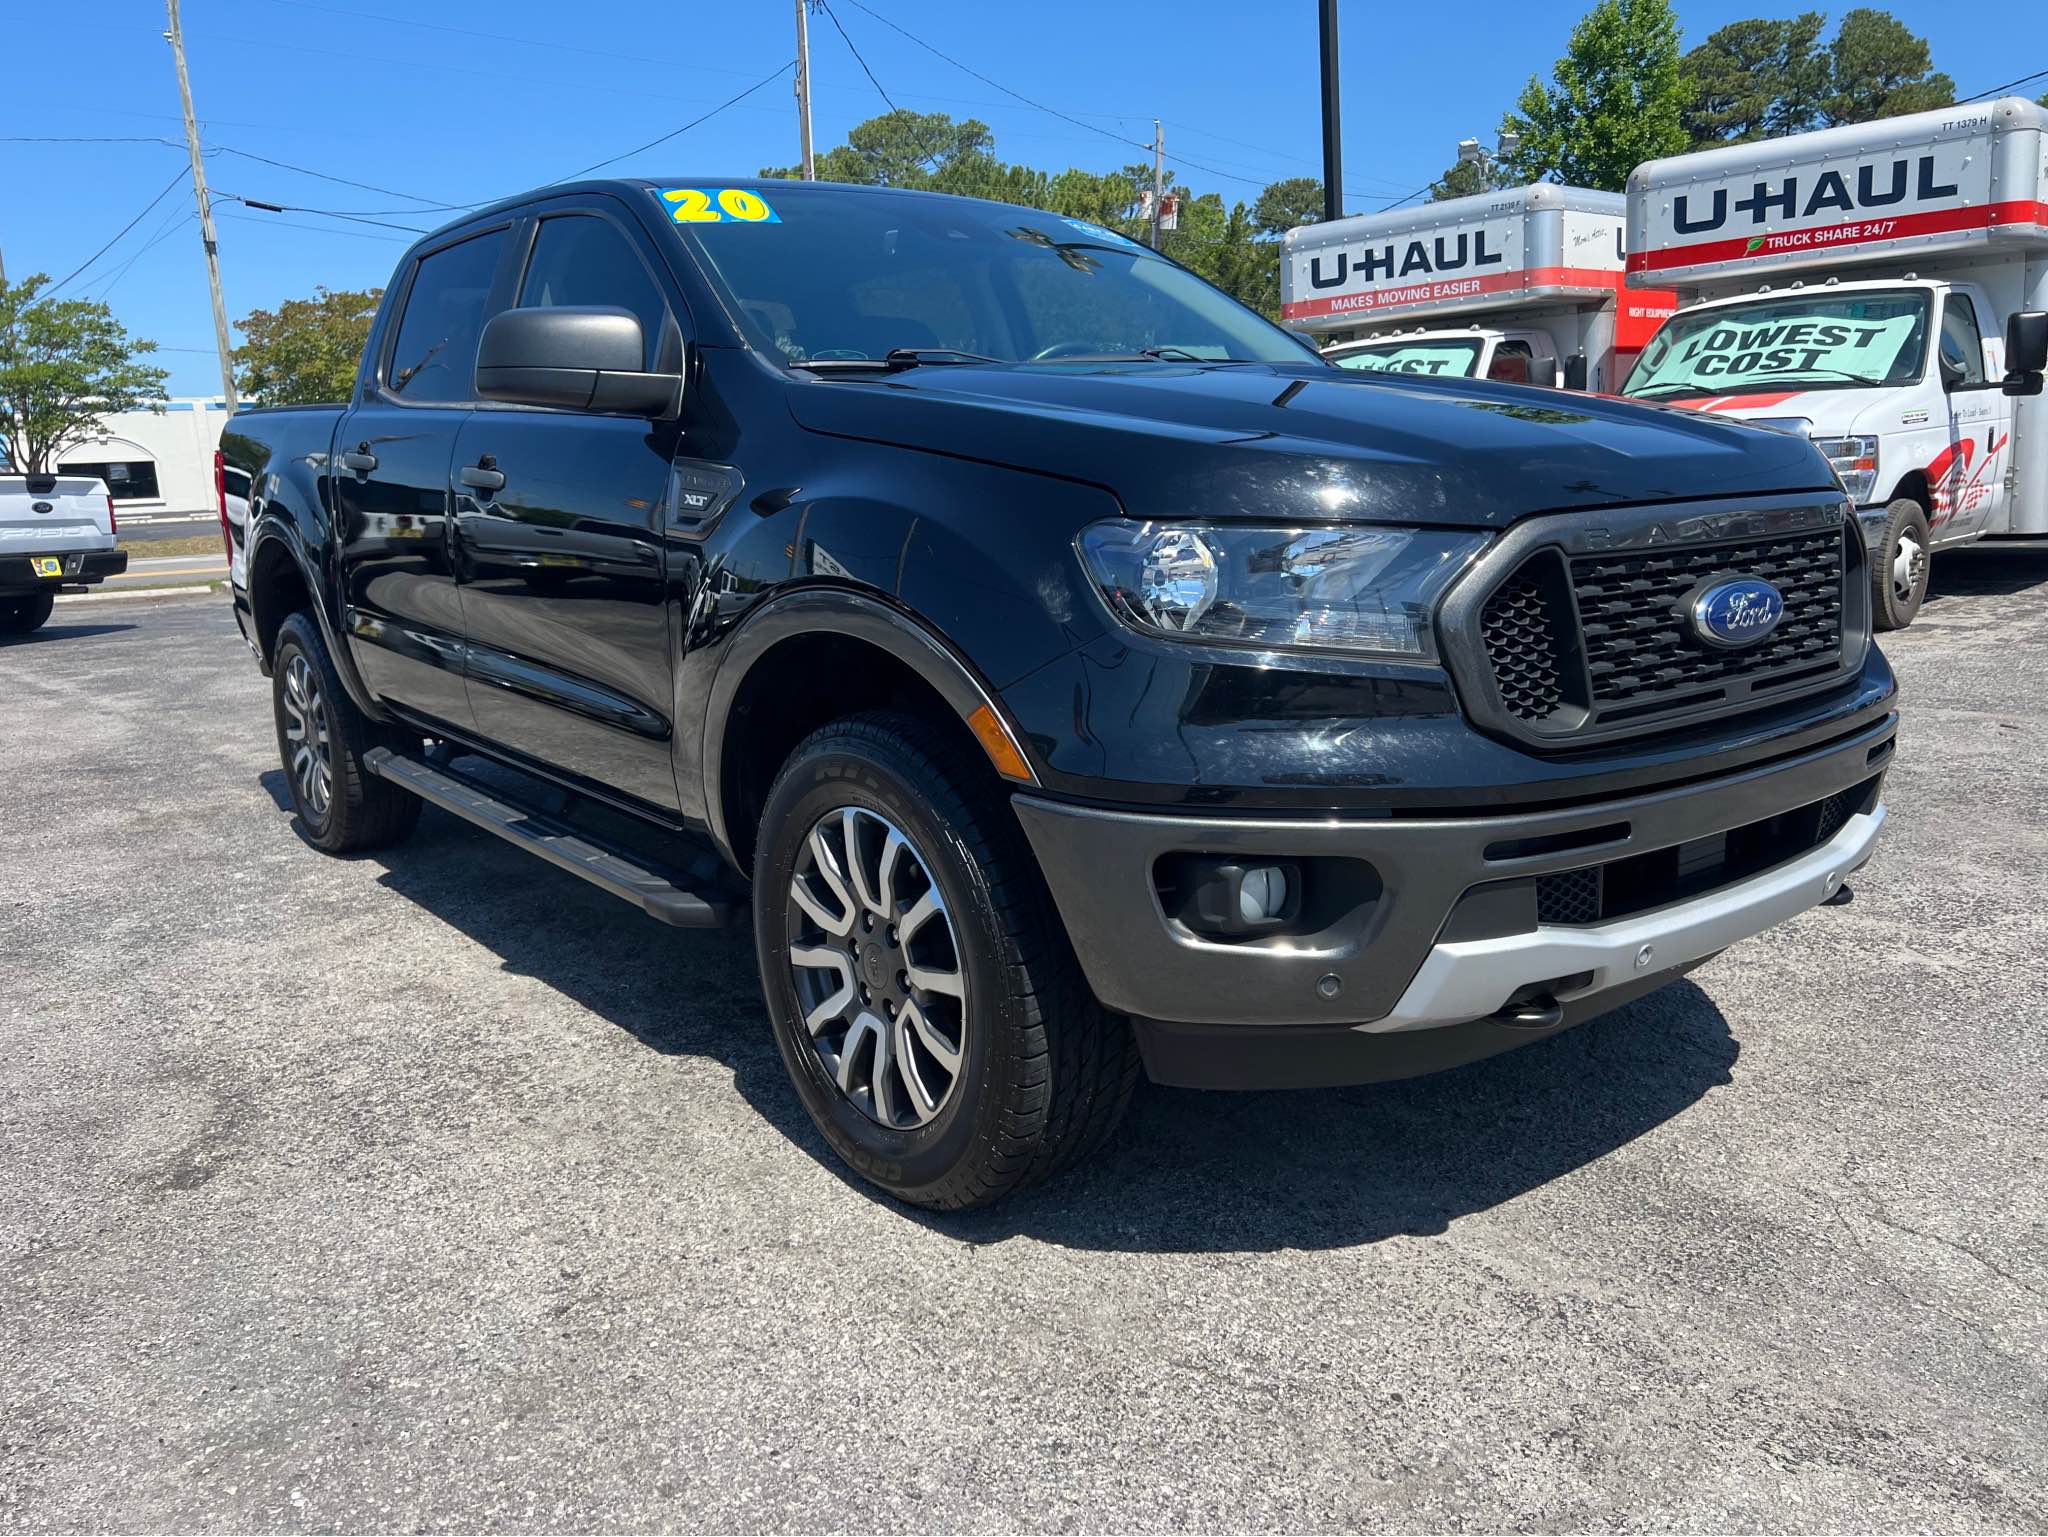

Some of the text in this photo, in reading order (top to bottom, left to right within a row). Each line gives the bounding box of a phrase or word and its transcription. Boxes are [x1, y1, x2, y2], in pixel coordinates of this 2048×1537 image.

[1942, 116, 1987, 131] TT 1379 H
[662, 189, 770, 222] 20
[1673, 155, 1958, 235] U-HAUL
[1766, 221, 1894, 249] TRUCK SHARE 24/7
[1310, 230, 1502, 290] U-HAUL
[1331, 280, 1481, 311] MAKES MOVING EASIER
[1680, 323, 1887, 364] LOWEST
[1693, 348, 1832, 376] COST
[684, 494, 708, 507] XLT
[1726, 591, 1772, 630] Ford
